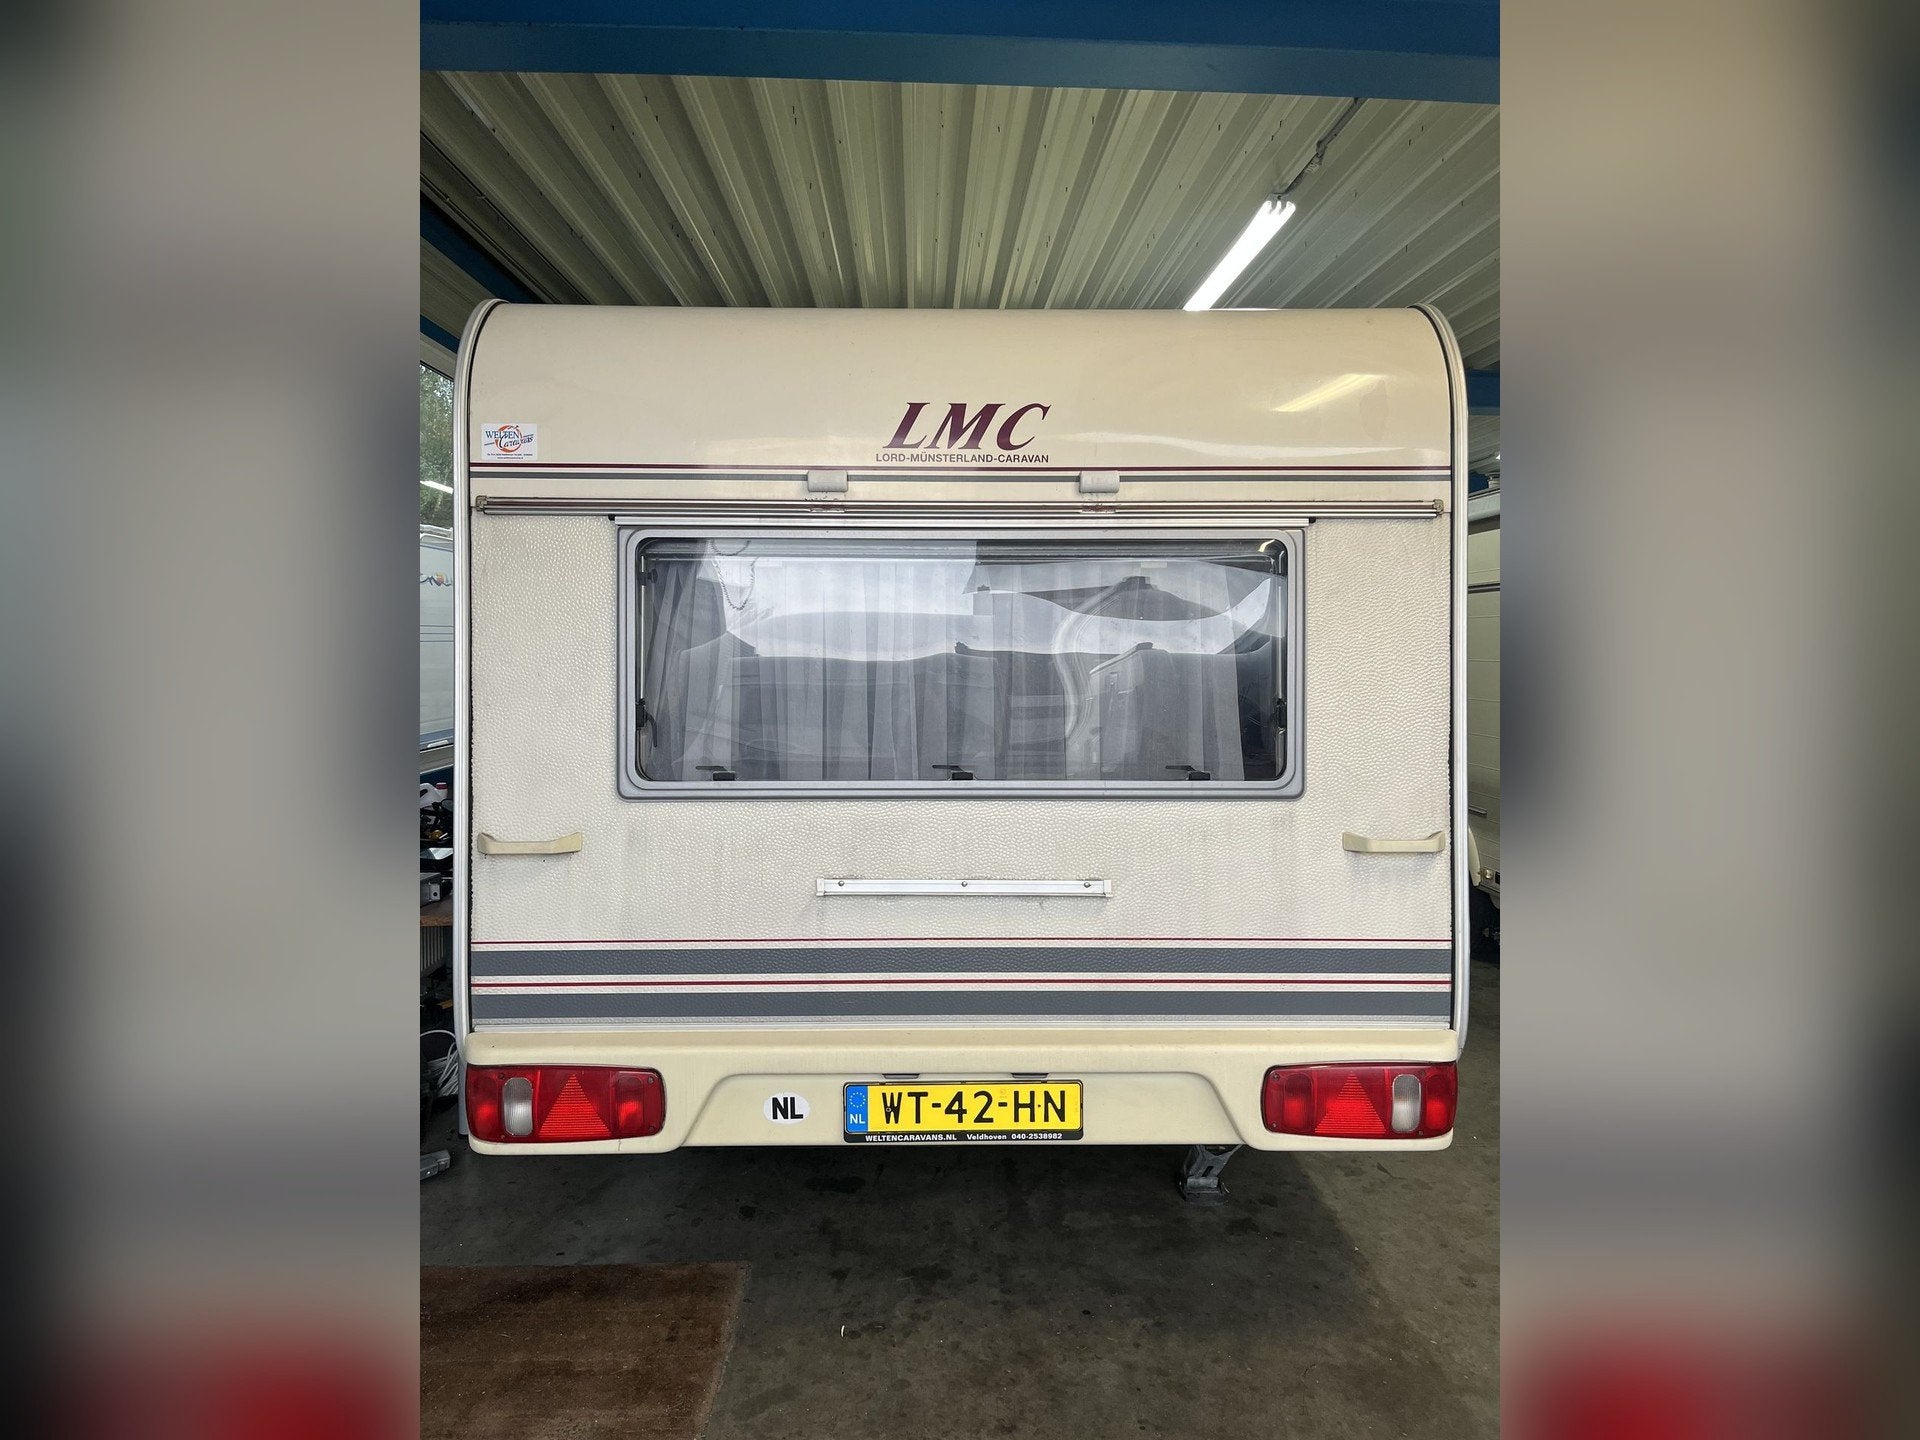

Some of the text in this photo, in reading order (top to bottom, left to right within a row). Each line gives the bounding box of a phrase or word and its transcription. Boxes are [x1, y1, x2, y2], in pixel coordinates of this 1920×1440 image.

[882, 402, 1052, 451] LMC
[875, 451, 1049, 463] LORD-MÜNSTERLAND-CARAVAN
[771, 1096, 804, 1120] NL
[882, 1090, 1065, 1124] WT-42-HN
[849, 1113, 866, 1124] NL
[865, 1133, 957, 1142] WELTENCARAVANS.NL
[1011, 1132, 1063, 1140] 040-2538982
